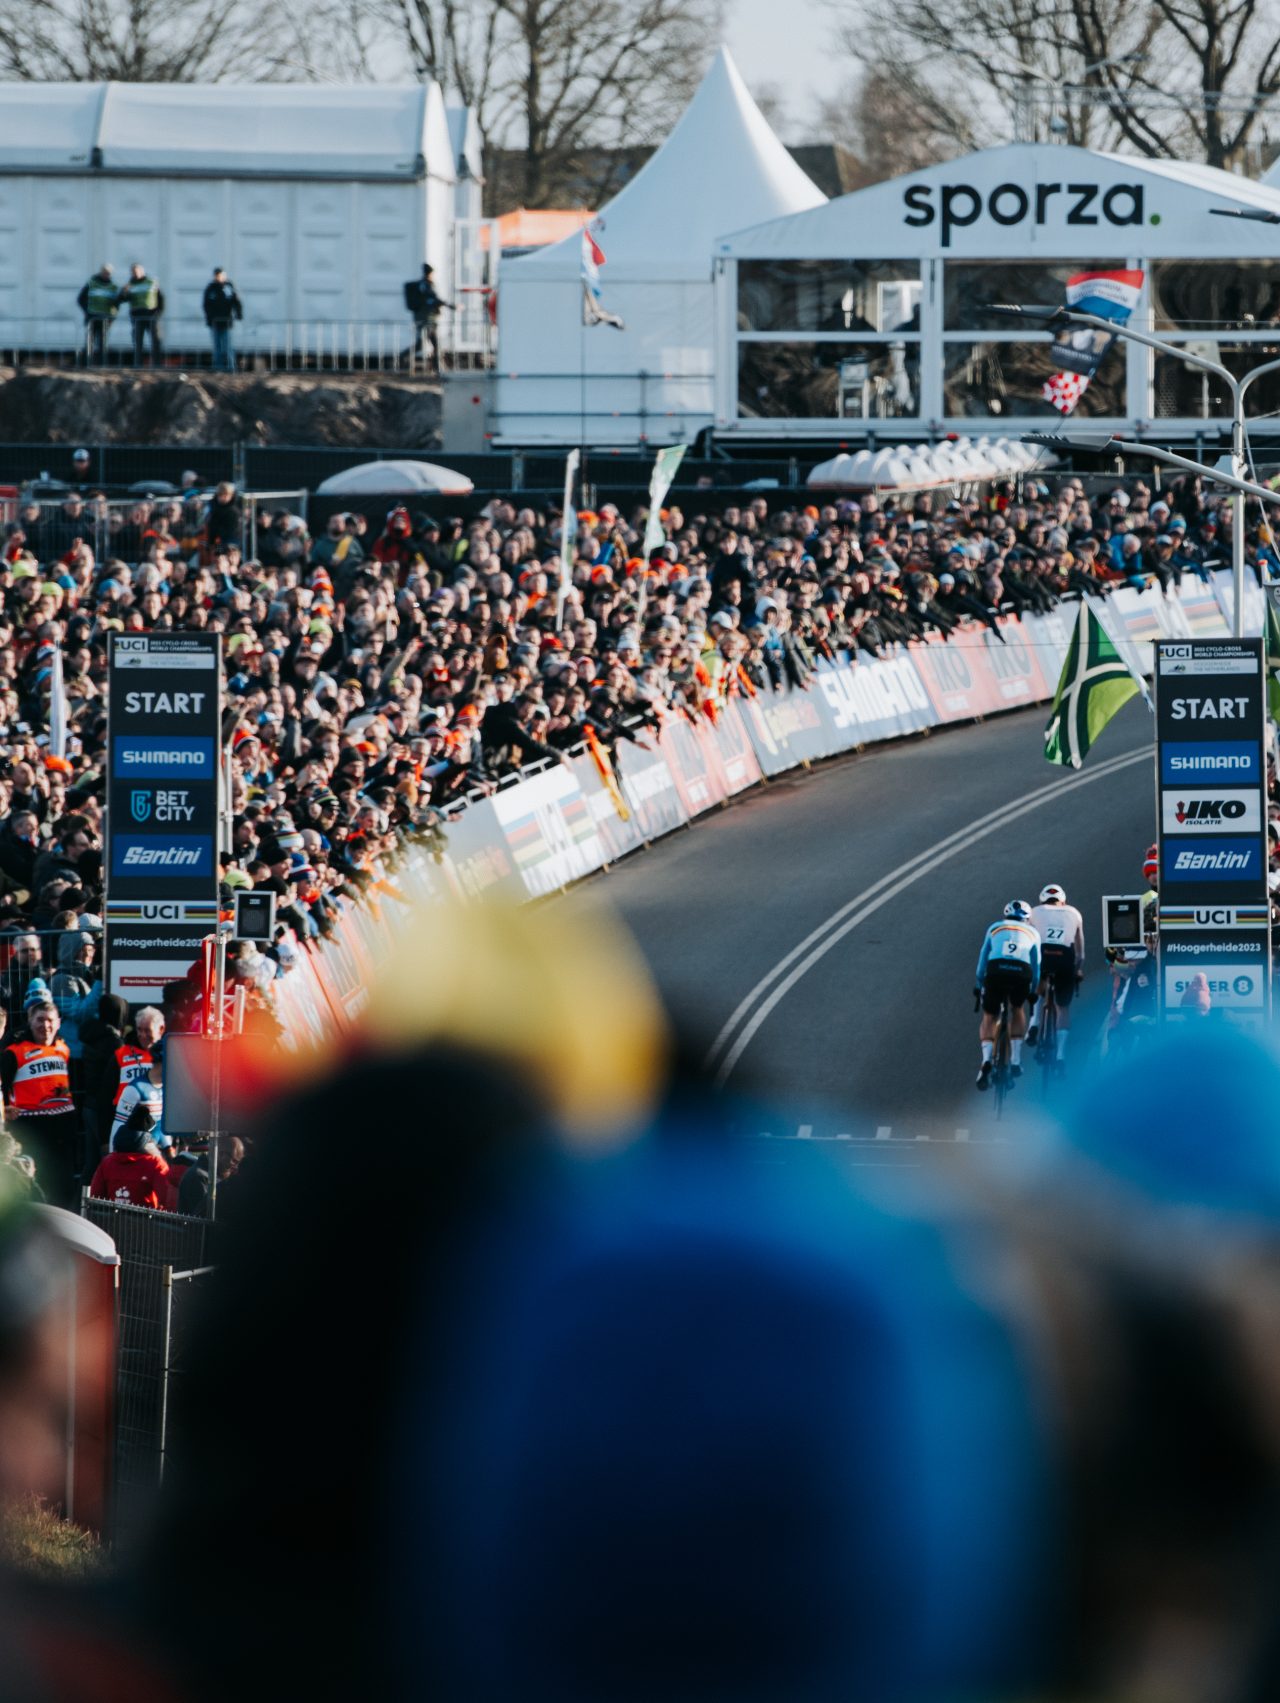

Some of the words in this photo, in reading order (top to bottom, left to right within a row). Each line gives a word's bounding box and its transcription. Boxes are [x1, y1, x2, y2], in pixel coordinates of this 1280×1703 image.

[121, 640, 146, 651] UCI
[1165, 647, 1190, 658] UCI
[124, 691, 206, 714] START
[1170, 697, 1250, 720] START
[122, 750, 205, 765] SHIMANO
[1170, 755, 1252, 770] SHIMANO
[155, 790, 189, 806] BET
[155, 806, 196, 821] CITY
[1186, 800, 1247, 819] IKO
[122, 846, 202, 866] Santini
[1173, 850, 1252, 870] Santini
[143, 905, 180, 920] UCI
[1195, 910, 1232, 925] UCI
[1047, 928, 1064, 939] 27
[112, 938, 203, 949] #Hoogerheide202
[1008, 943, 1017, 953] 9
[1166, 943, 1262, 955] #Hoogerheide2023
[1175, 981, 1230, 993] SER
